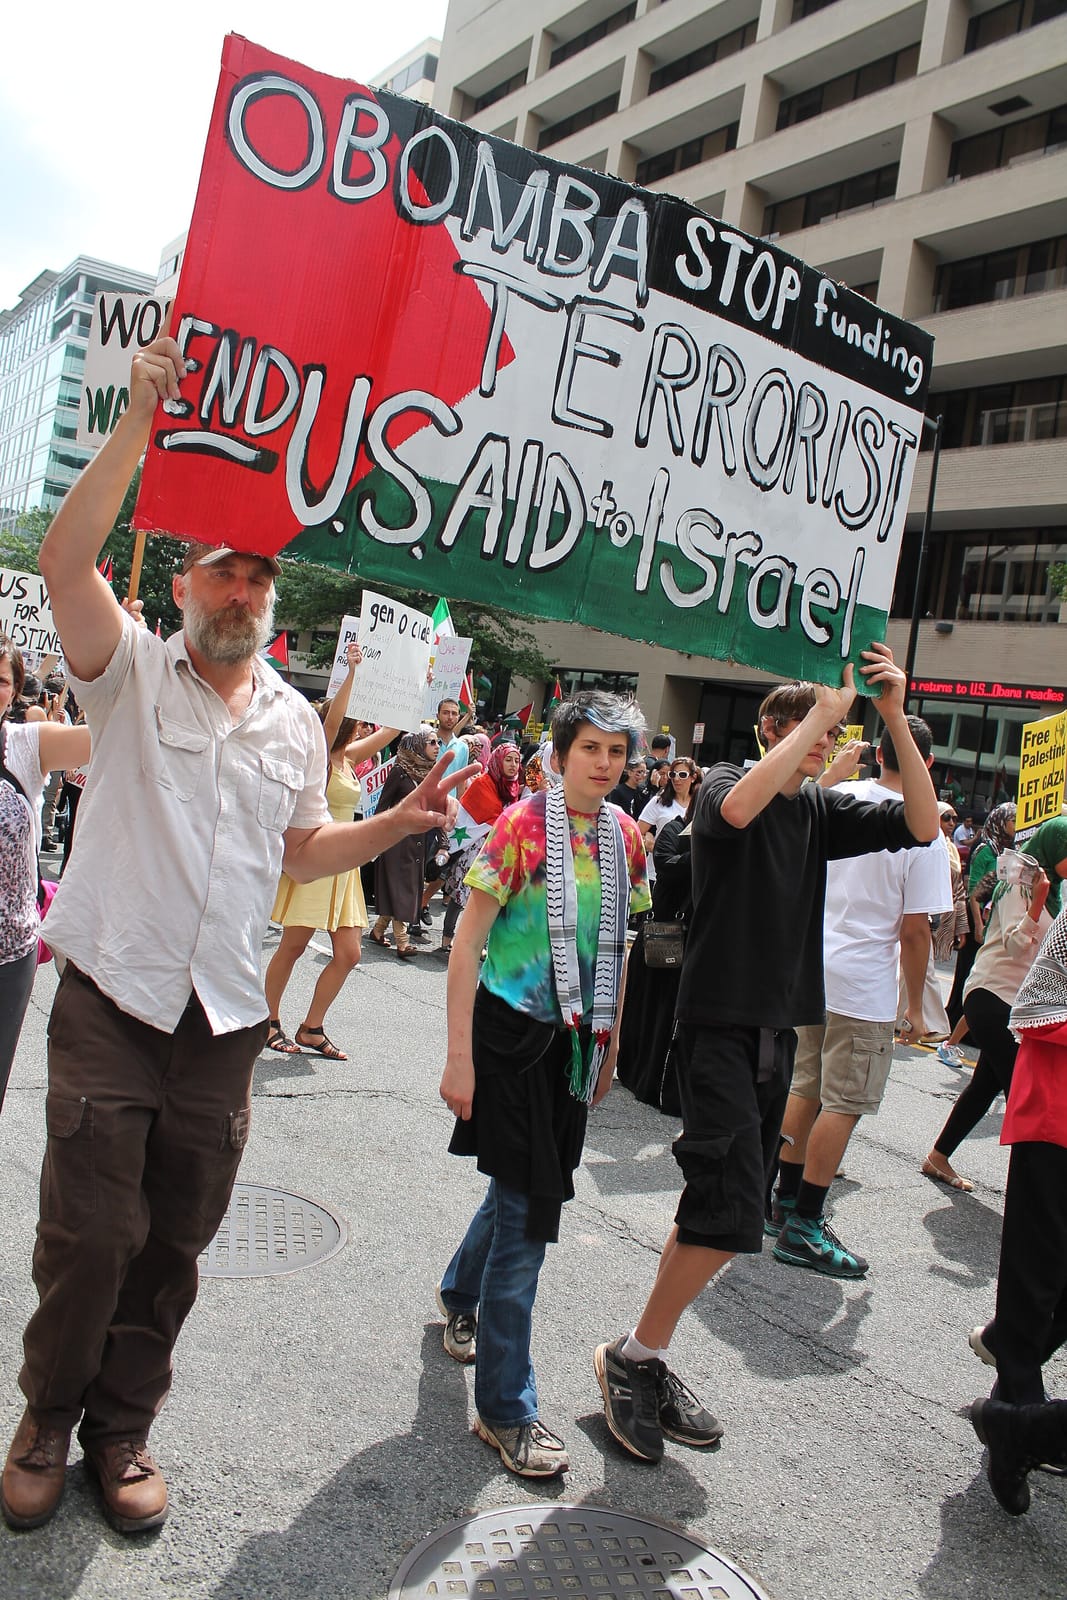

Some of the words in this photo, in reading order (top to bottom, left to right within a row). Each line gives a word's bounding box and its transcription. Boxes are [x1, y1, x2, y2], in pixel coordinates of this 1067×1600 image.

[226, 71, 649, 308] OBOMBA
[675, 217, 800, 330] STOP
[814, 279, 924, 395] funding
[453, 259, 917, 542] TERRORIST
[162, 313, 300, 436] END
[438, 432, 587, 574] AID
[591, 480, 635, 548] to
[633, 467, 866, 659] Israel
[13, 603, 40, 622] FOR
[370, 603, 394, 632] gen
[361, 645, 382, 660] noun
[919, 681, 953, 694] returns
[956, 683, 967, 695] to
[1025, 688, 1065, 702] readies
[1023, 729, 1050, 749] Free
[1021, 743, 1066, 770] Palestine
[1020, 778, 1040, 798] LET
[1042, 769, 1065, 791] GAZA
[1023, 791, 1059, 823] LIVE!
